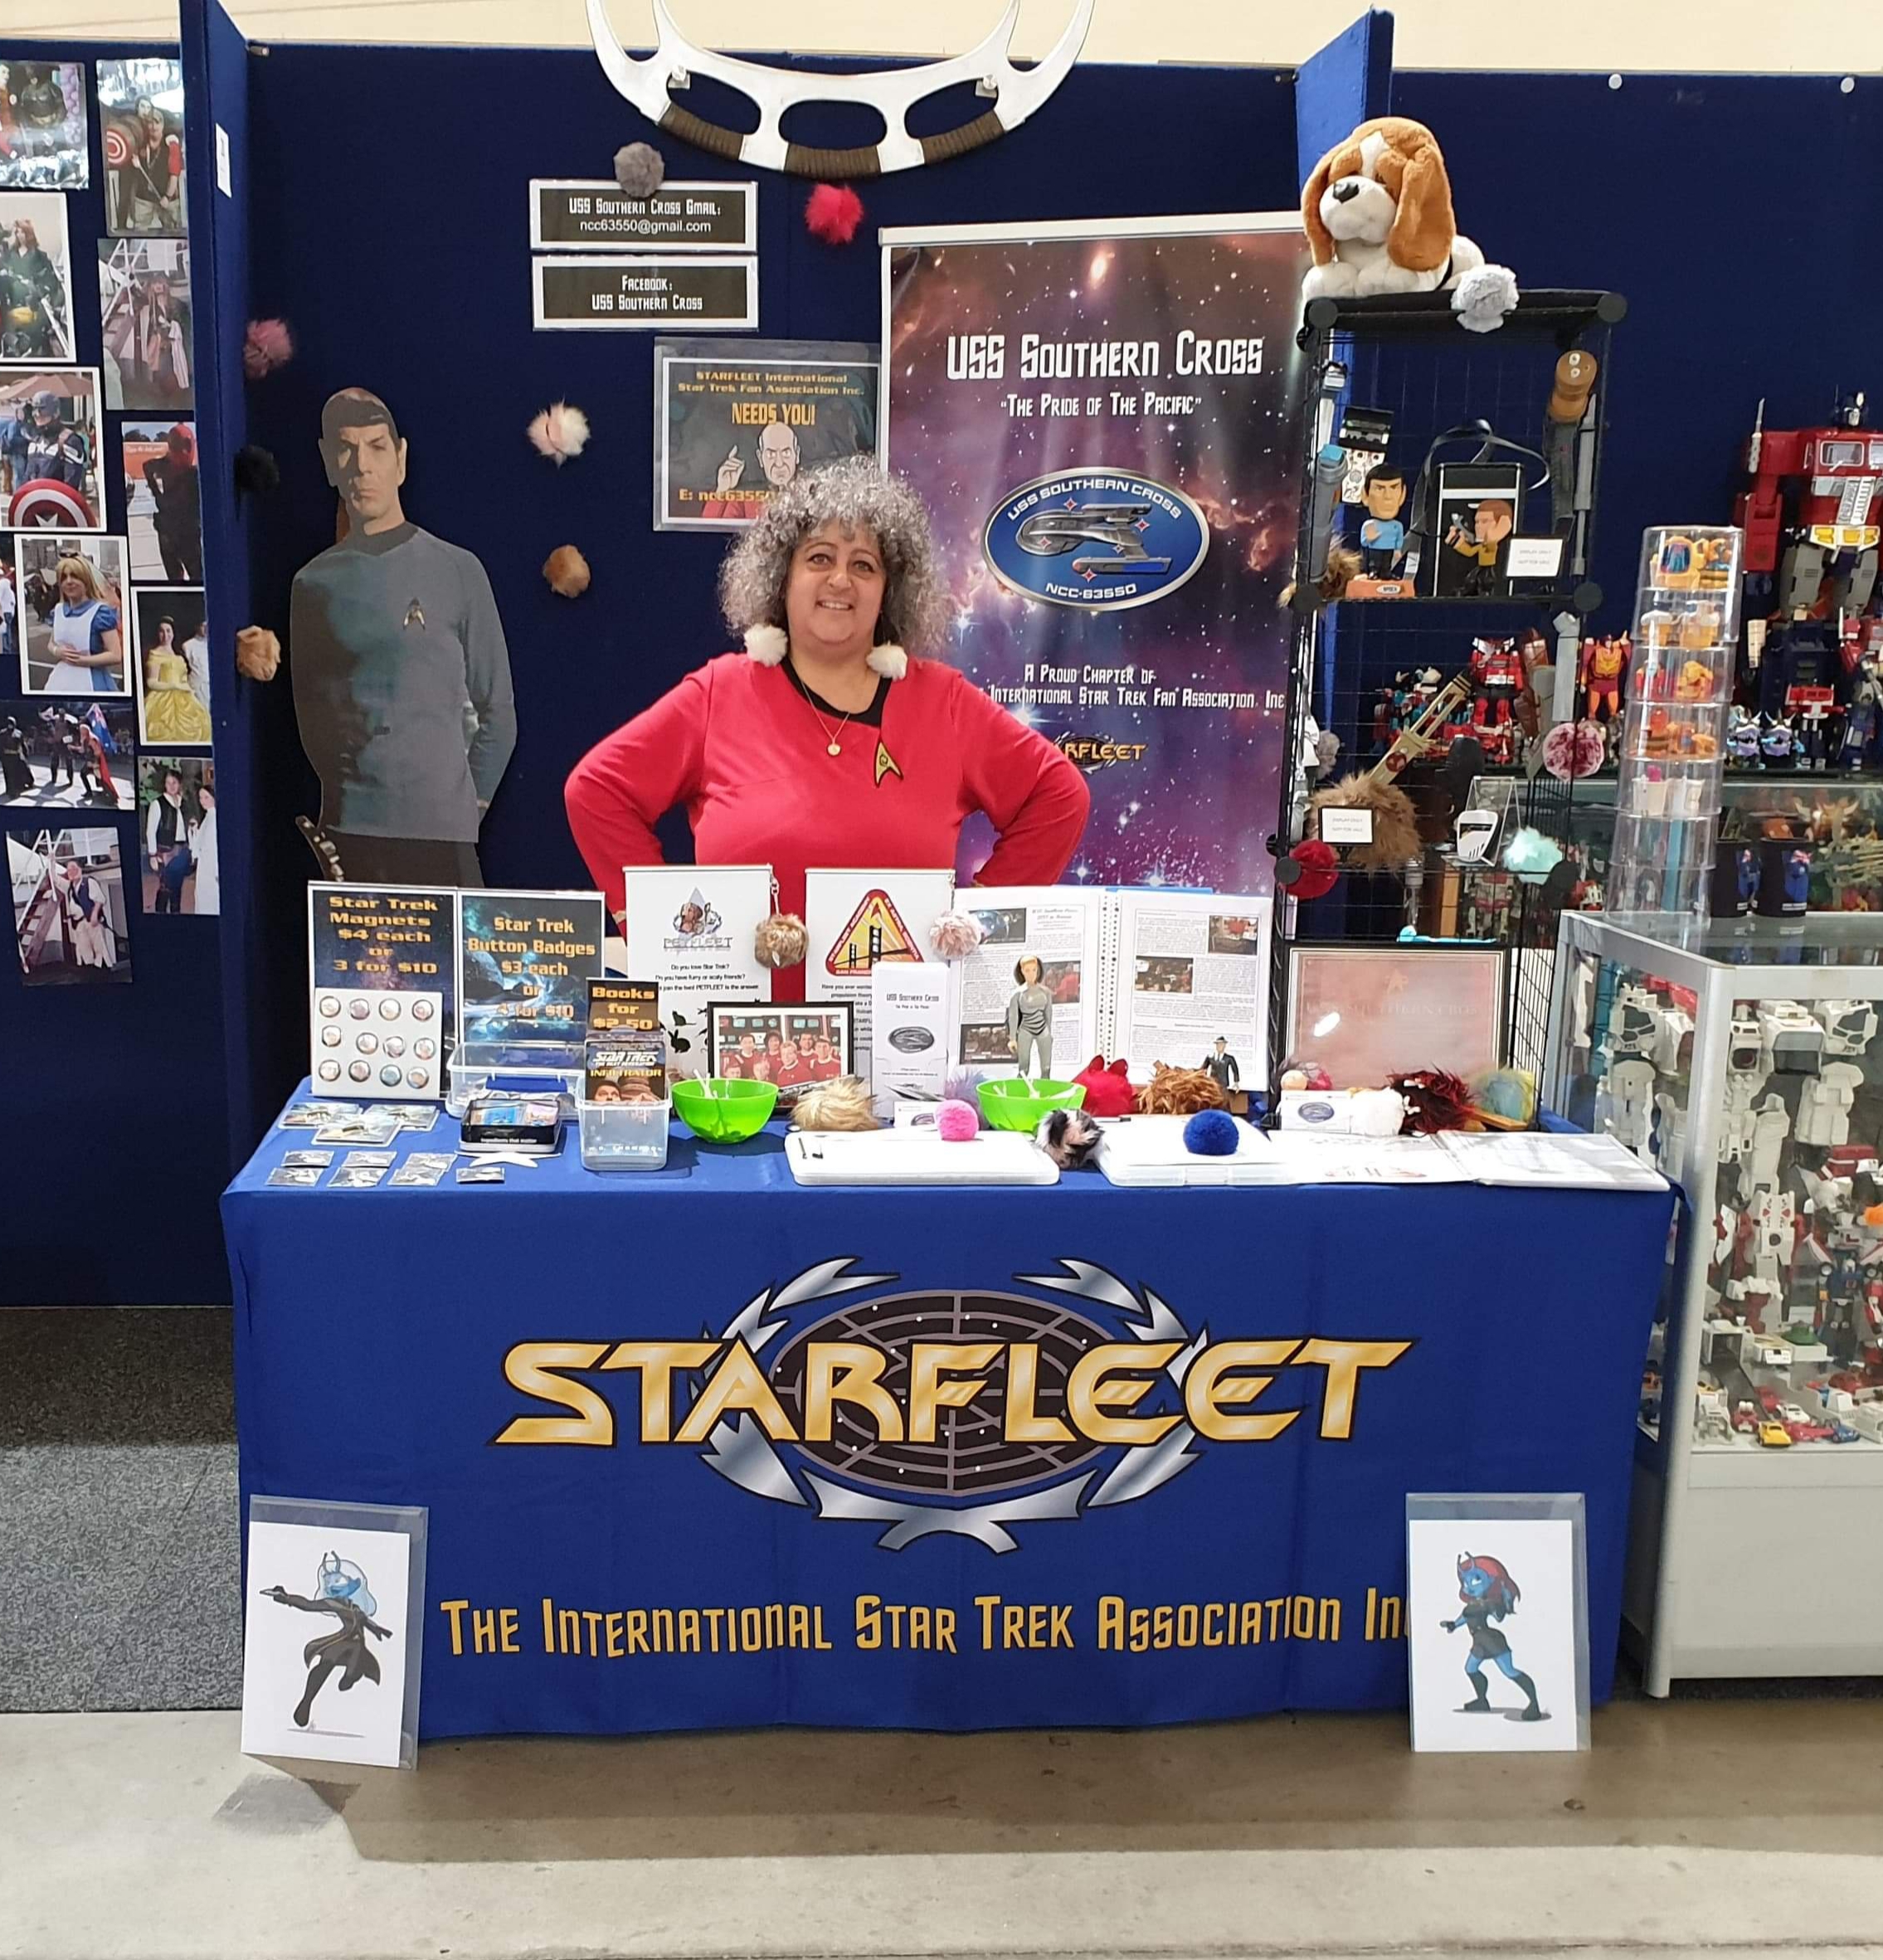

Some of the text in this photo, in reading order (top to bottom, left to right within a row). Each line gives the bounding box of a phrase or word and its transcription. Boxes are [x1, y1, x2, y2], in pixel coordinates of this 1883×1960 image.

[569, 197, 591, 214] USS
[596, 198, 645, 215] SOUTHERN
[650, 198, 681, 215] CROSS
[580, 219, 712, 234] ncc63550@gmail.com
[622, 275, 673, 290] FACEBOOK:
[591, 294, 703, 310] USS SOUTHERN CROSS
[947, 330, 1263, 380] USS SOUTHERN CROSS
[696, 371, 848, 383] STARFLEET International
[678, 382, 864, 396] Star Trek Fan Association Inc.
[1040, 393, 1079, 416] PRIDE
[1110, 392, 1136, 416] THE
[732, 402, 815, 426] NEEDS YOU!
[679, 489, 693, 501] E:
[1007, 479, 1182, 521] USS SOUTHERN CROSS
[1045, 582, 1137, 600] NCC-63550
[1024, 664, 1034, 683] A
[1039, 664, 1078, 683] PROUD
[1083, 664, 1134, 684] CHAPTER
[1079, 686, 1109, 705] STAR
[1117, 687, 1146, 706] TREK
[1154, 688, 1175, 707] FAN
[1065, 742, 1147, 761] RFLEET
[329, 896, 438, 911] Star Trek
[330, 912, 431, 927] Magnets
[494, 917, 575, 933] Star Trek
[338, 928, 431, 942] $4 each
[468, 937, 596, 958] Button Badges
[664, 937, 732, 949] PETFLEET
[368, 947, 393, 956] or
[333, 960, 437, 974] 3 for $10
[501, 960, 568, 975] $3 each
[523, 985, 540, 995] or
[592, 987, 654, 999] Books
[515, 1005, 538, 1017] for
[545, 1004, 573, 1018] $10
[608, 1003, 640, 1014] for
[493, 1337, 1416, 1446] STARFLEET
[440, 1599, 520, 1656] THE
[542, 1598, 832, 1658] INTERNATIONAL
[855, 1595, 956, 1654] STAR
[974, 1595, 1075, 1650] TREK
[1098, 1594, 1340, 1652] ASSOCIATION
